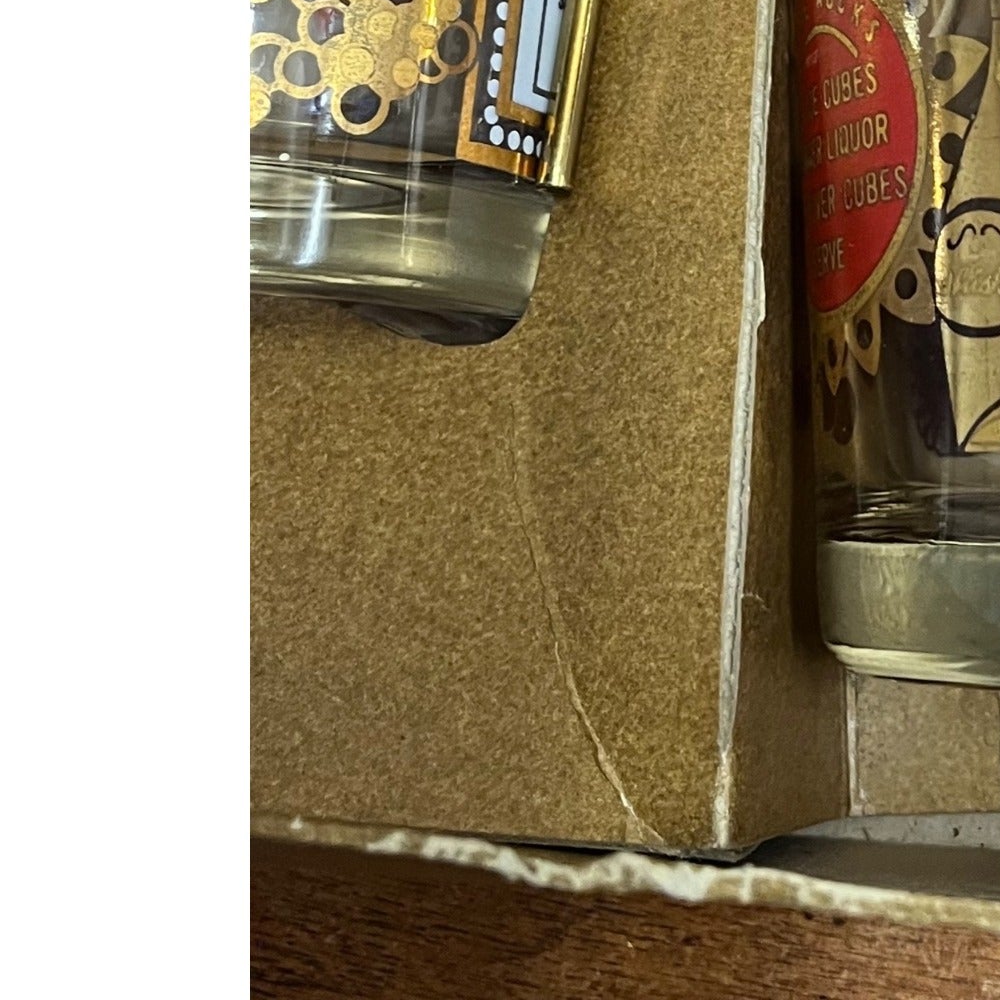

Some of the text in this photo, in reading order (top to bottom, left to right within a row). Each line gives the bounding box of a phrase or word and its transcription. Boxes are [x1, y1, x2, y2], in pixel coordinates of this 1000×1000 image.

[823, 61, 878, 110] CUBES
[826, 113, 889, 161] LIQUOR
[843, 164, 908, 211] CUBES
